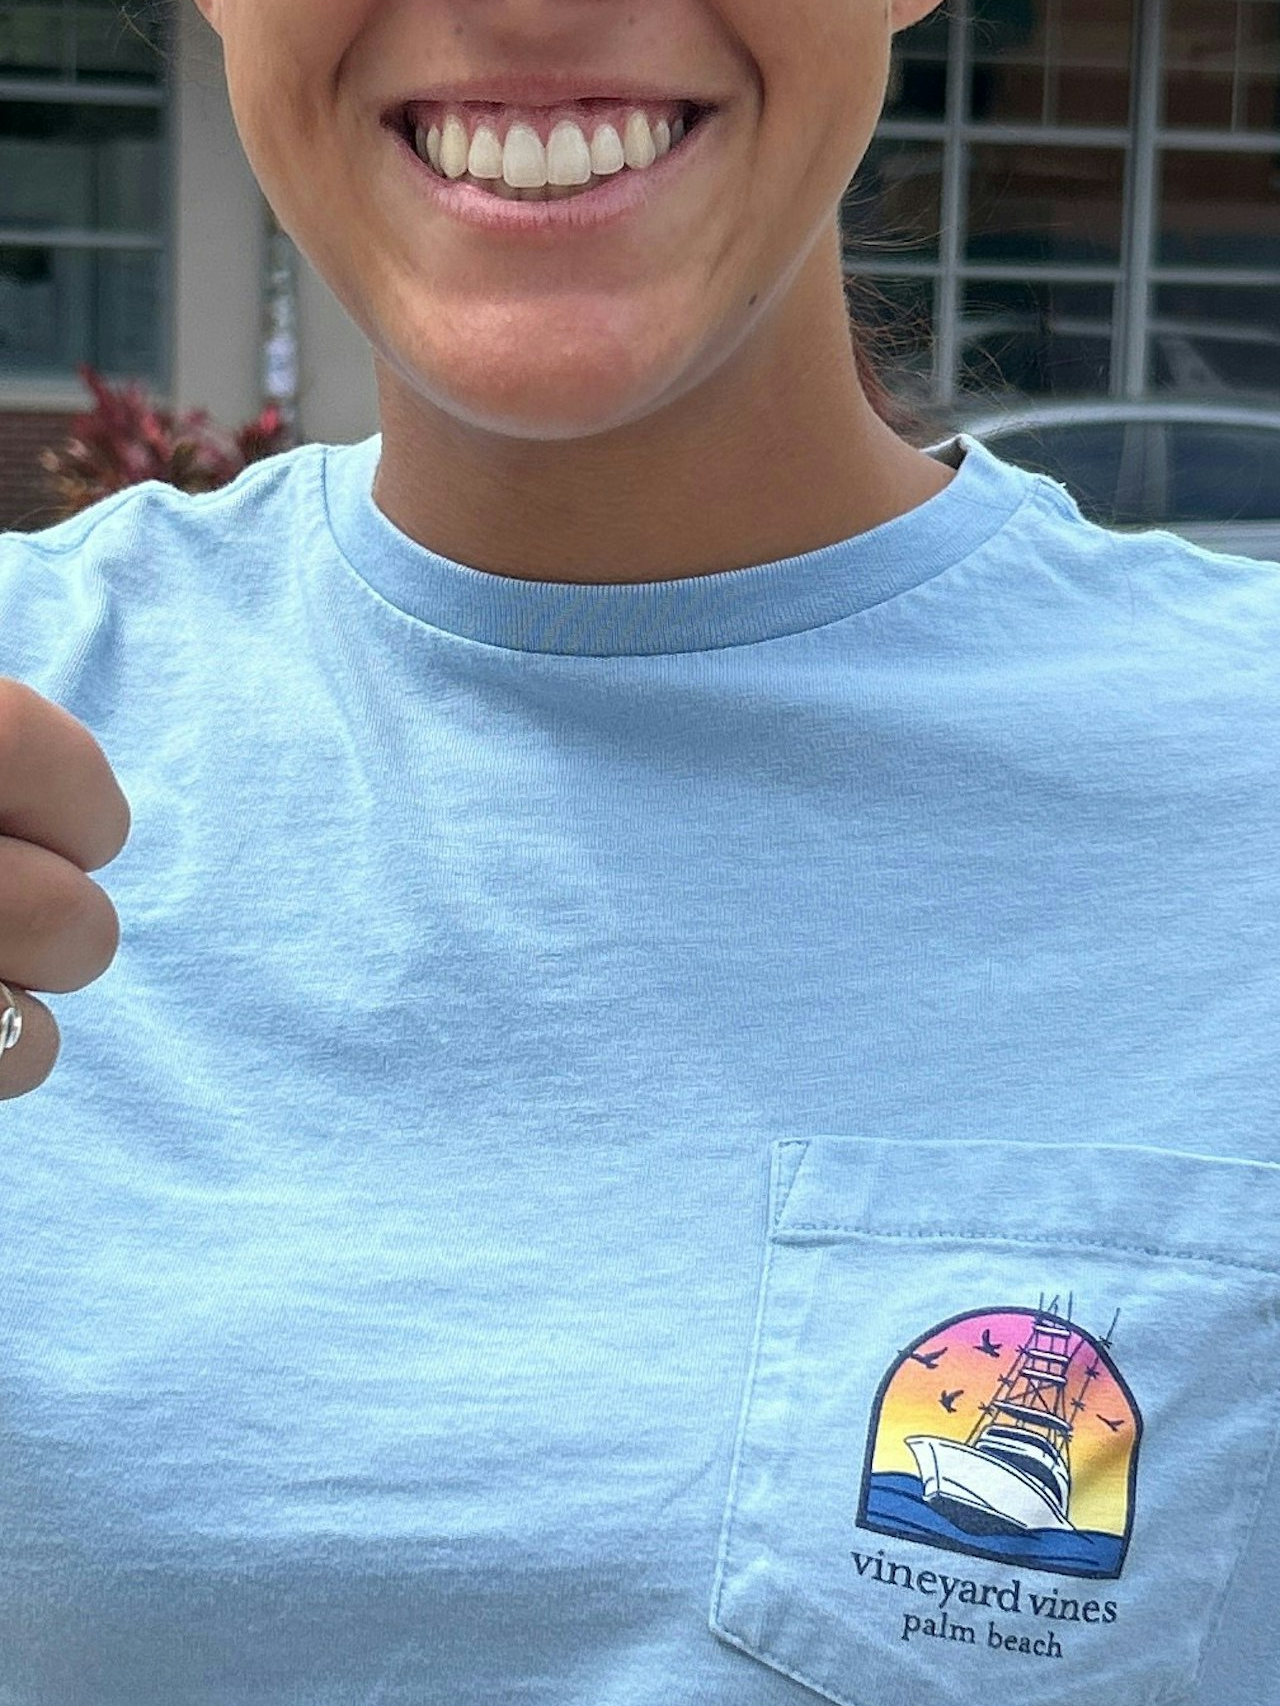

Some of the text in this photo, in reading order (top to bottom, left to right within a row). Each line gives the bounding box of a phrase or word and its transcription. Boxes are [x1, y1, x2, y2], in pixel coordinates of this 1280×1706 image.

[850, 1549, 1118, 1624] vineyard vines
[901, 1612, 1063, 1658] palm beach
